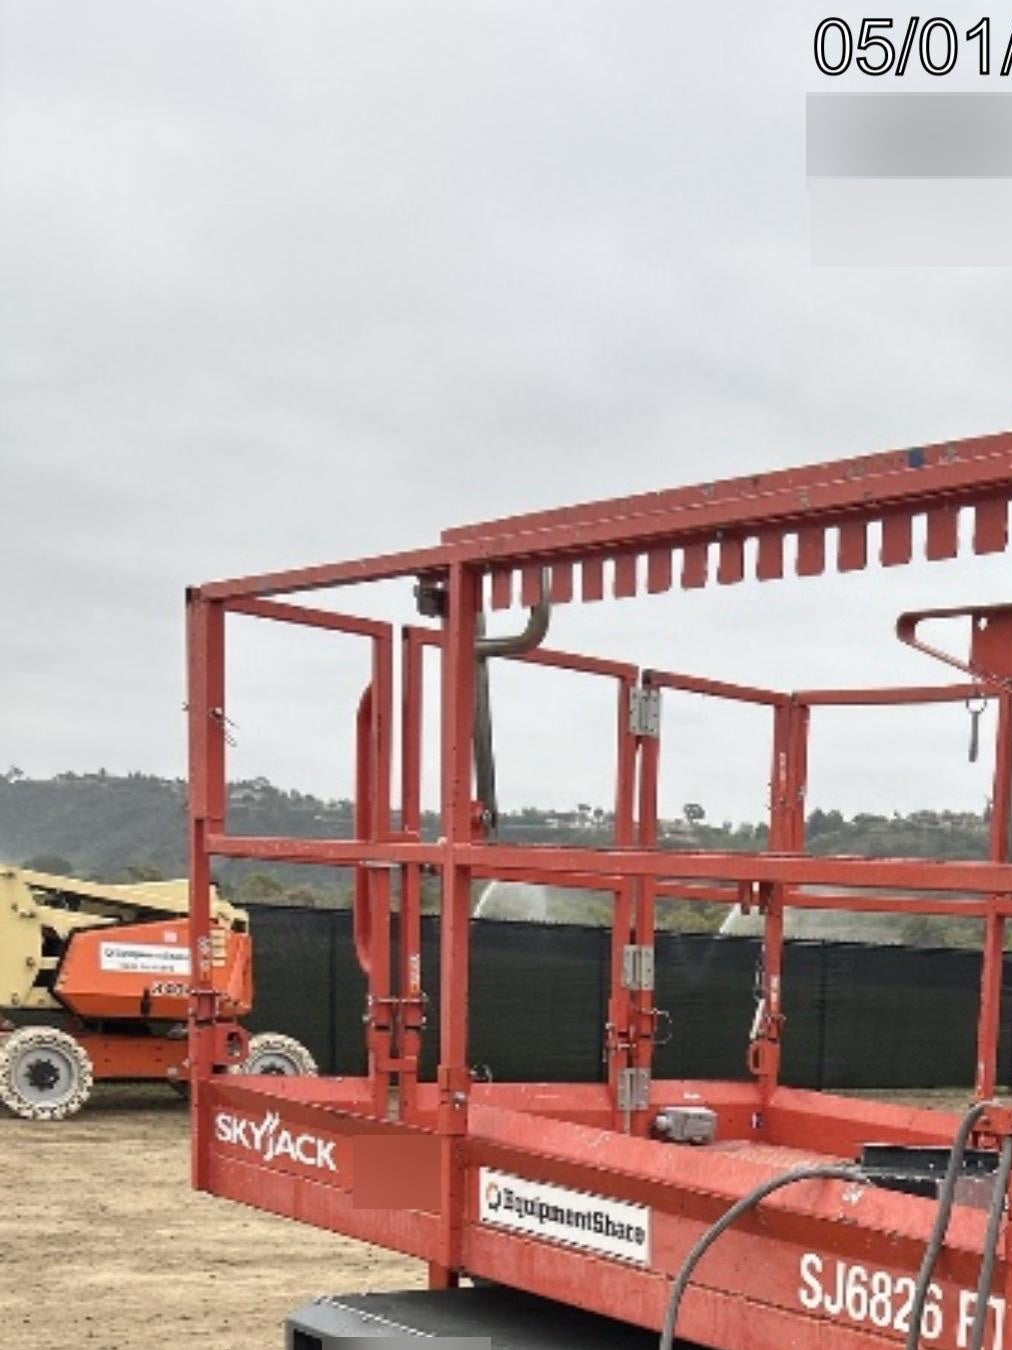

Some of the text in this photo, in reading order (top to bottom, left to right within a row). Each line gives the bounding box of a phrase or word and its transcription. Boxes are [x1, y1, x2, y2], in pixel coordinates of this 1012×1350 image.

[215, 1109, 337, 1172] SKYJACK
[502, 1186, 646, 1246] EquipmentShare
[800, 1252, 943, 1339] SJ6826
